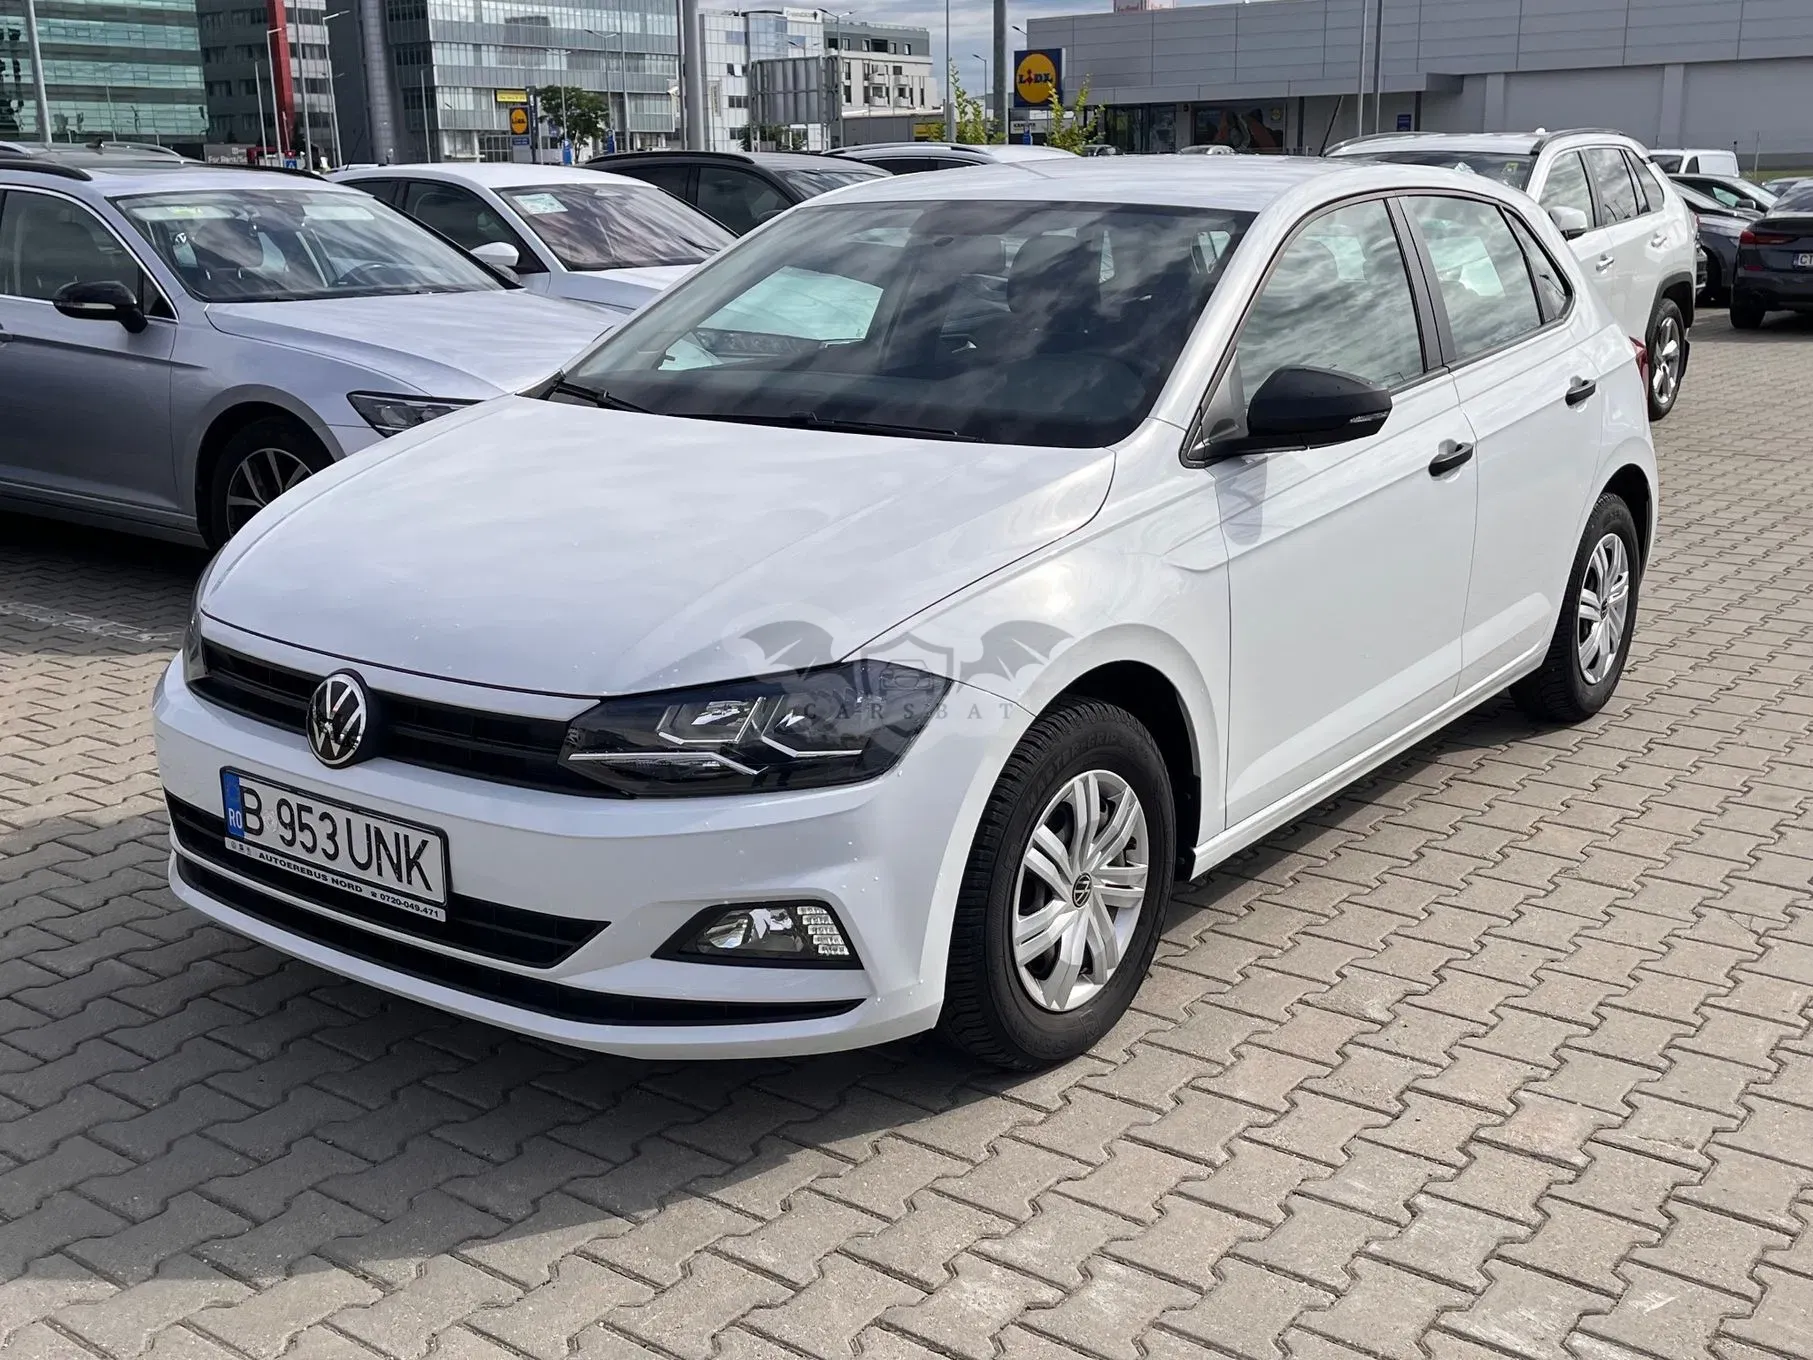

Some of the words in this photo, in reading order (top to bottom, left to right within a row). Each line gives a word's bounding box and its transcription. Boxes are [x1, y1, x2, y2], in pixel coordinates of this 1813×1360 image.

[228, 807, 243, 829] RO
[240, 786, 264, 836] B
[276, 798, 339, 861] 953
[346, 817, 433, 892] UNK
[259, 852, 328, 881] AUTOEREBUS
[331, 877, 363, 893] NORD
